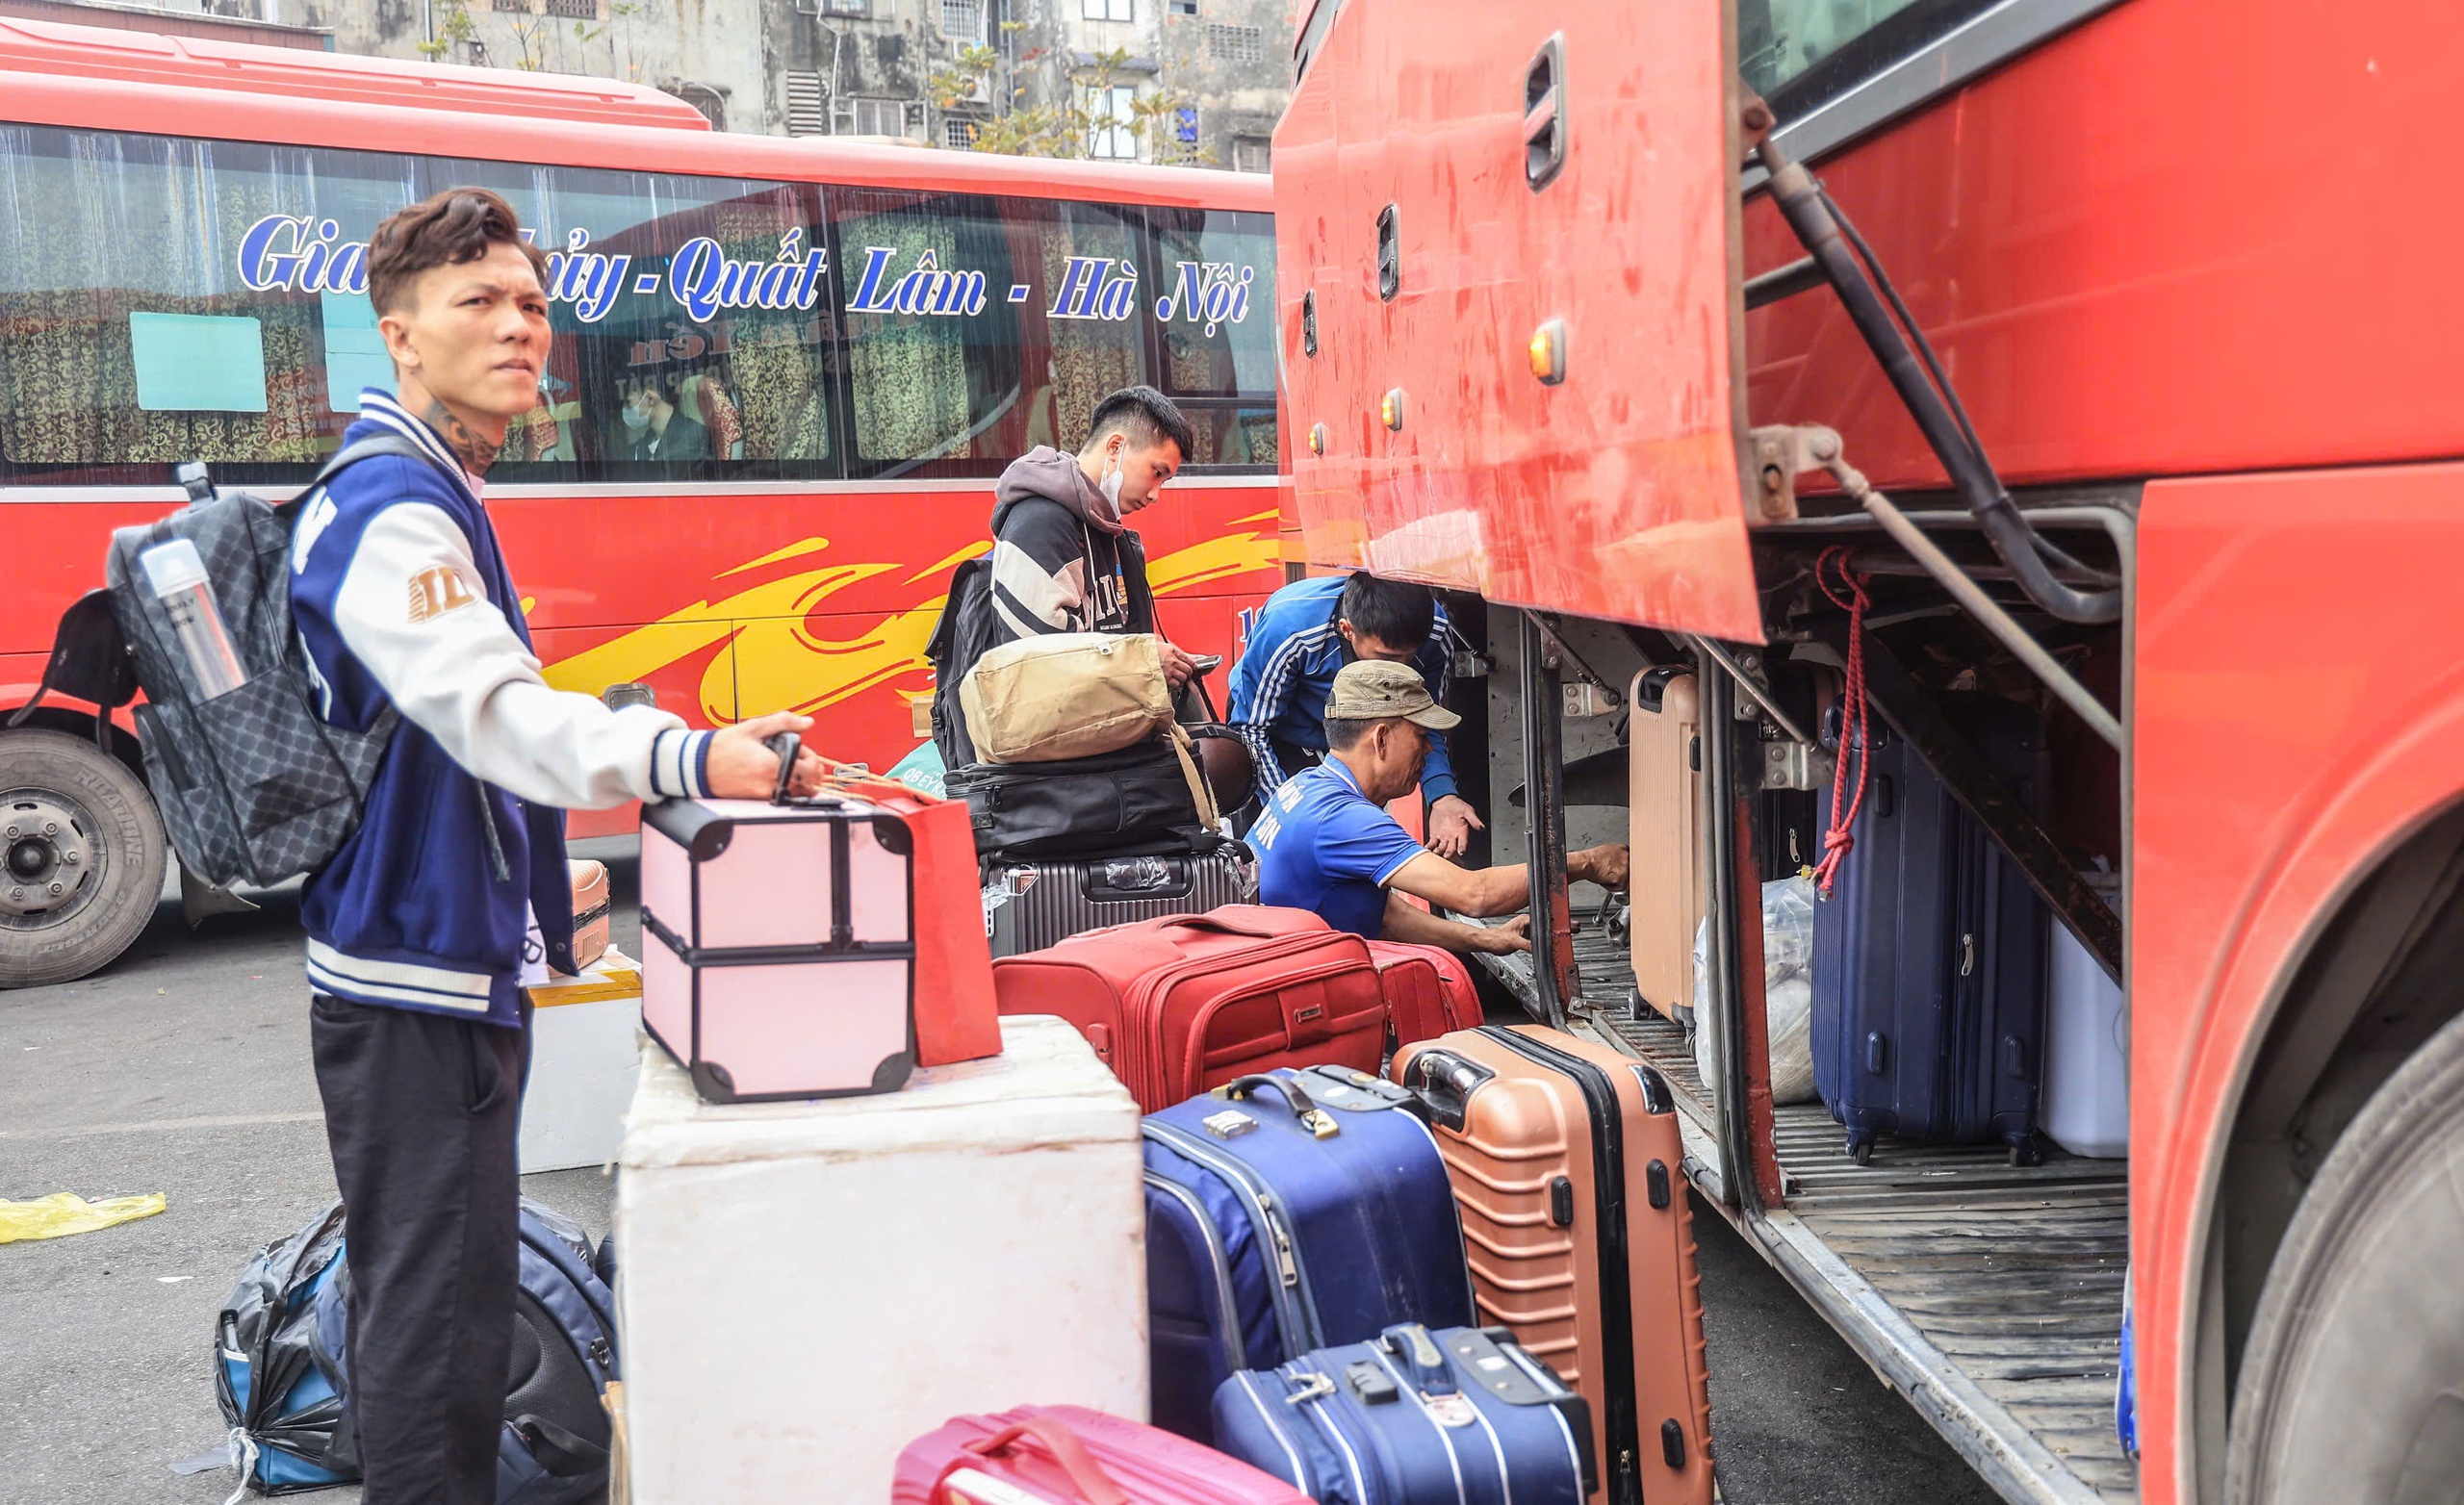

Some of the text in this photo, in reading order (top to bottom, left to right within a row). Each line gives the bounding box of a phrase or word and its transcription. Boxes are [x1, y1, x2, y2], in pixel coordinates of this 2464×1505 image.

[237, 214, 372, 295] Gia
[669, 226, 828, 324] Quất
[844, 246, 988, 319] Lâm
[1045, 255, 1139, 321] Hà
[1155, 261, 1255, 339] Nội
